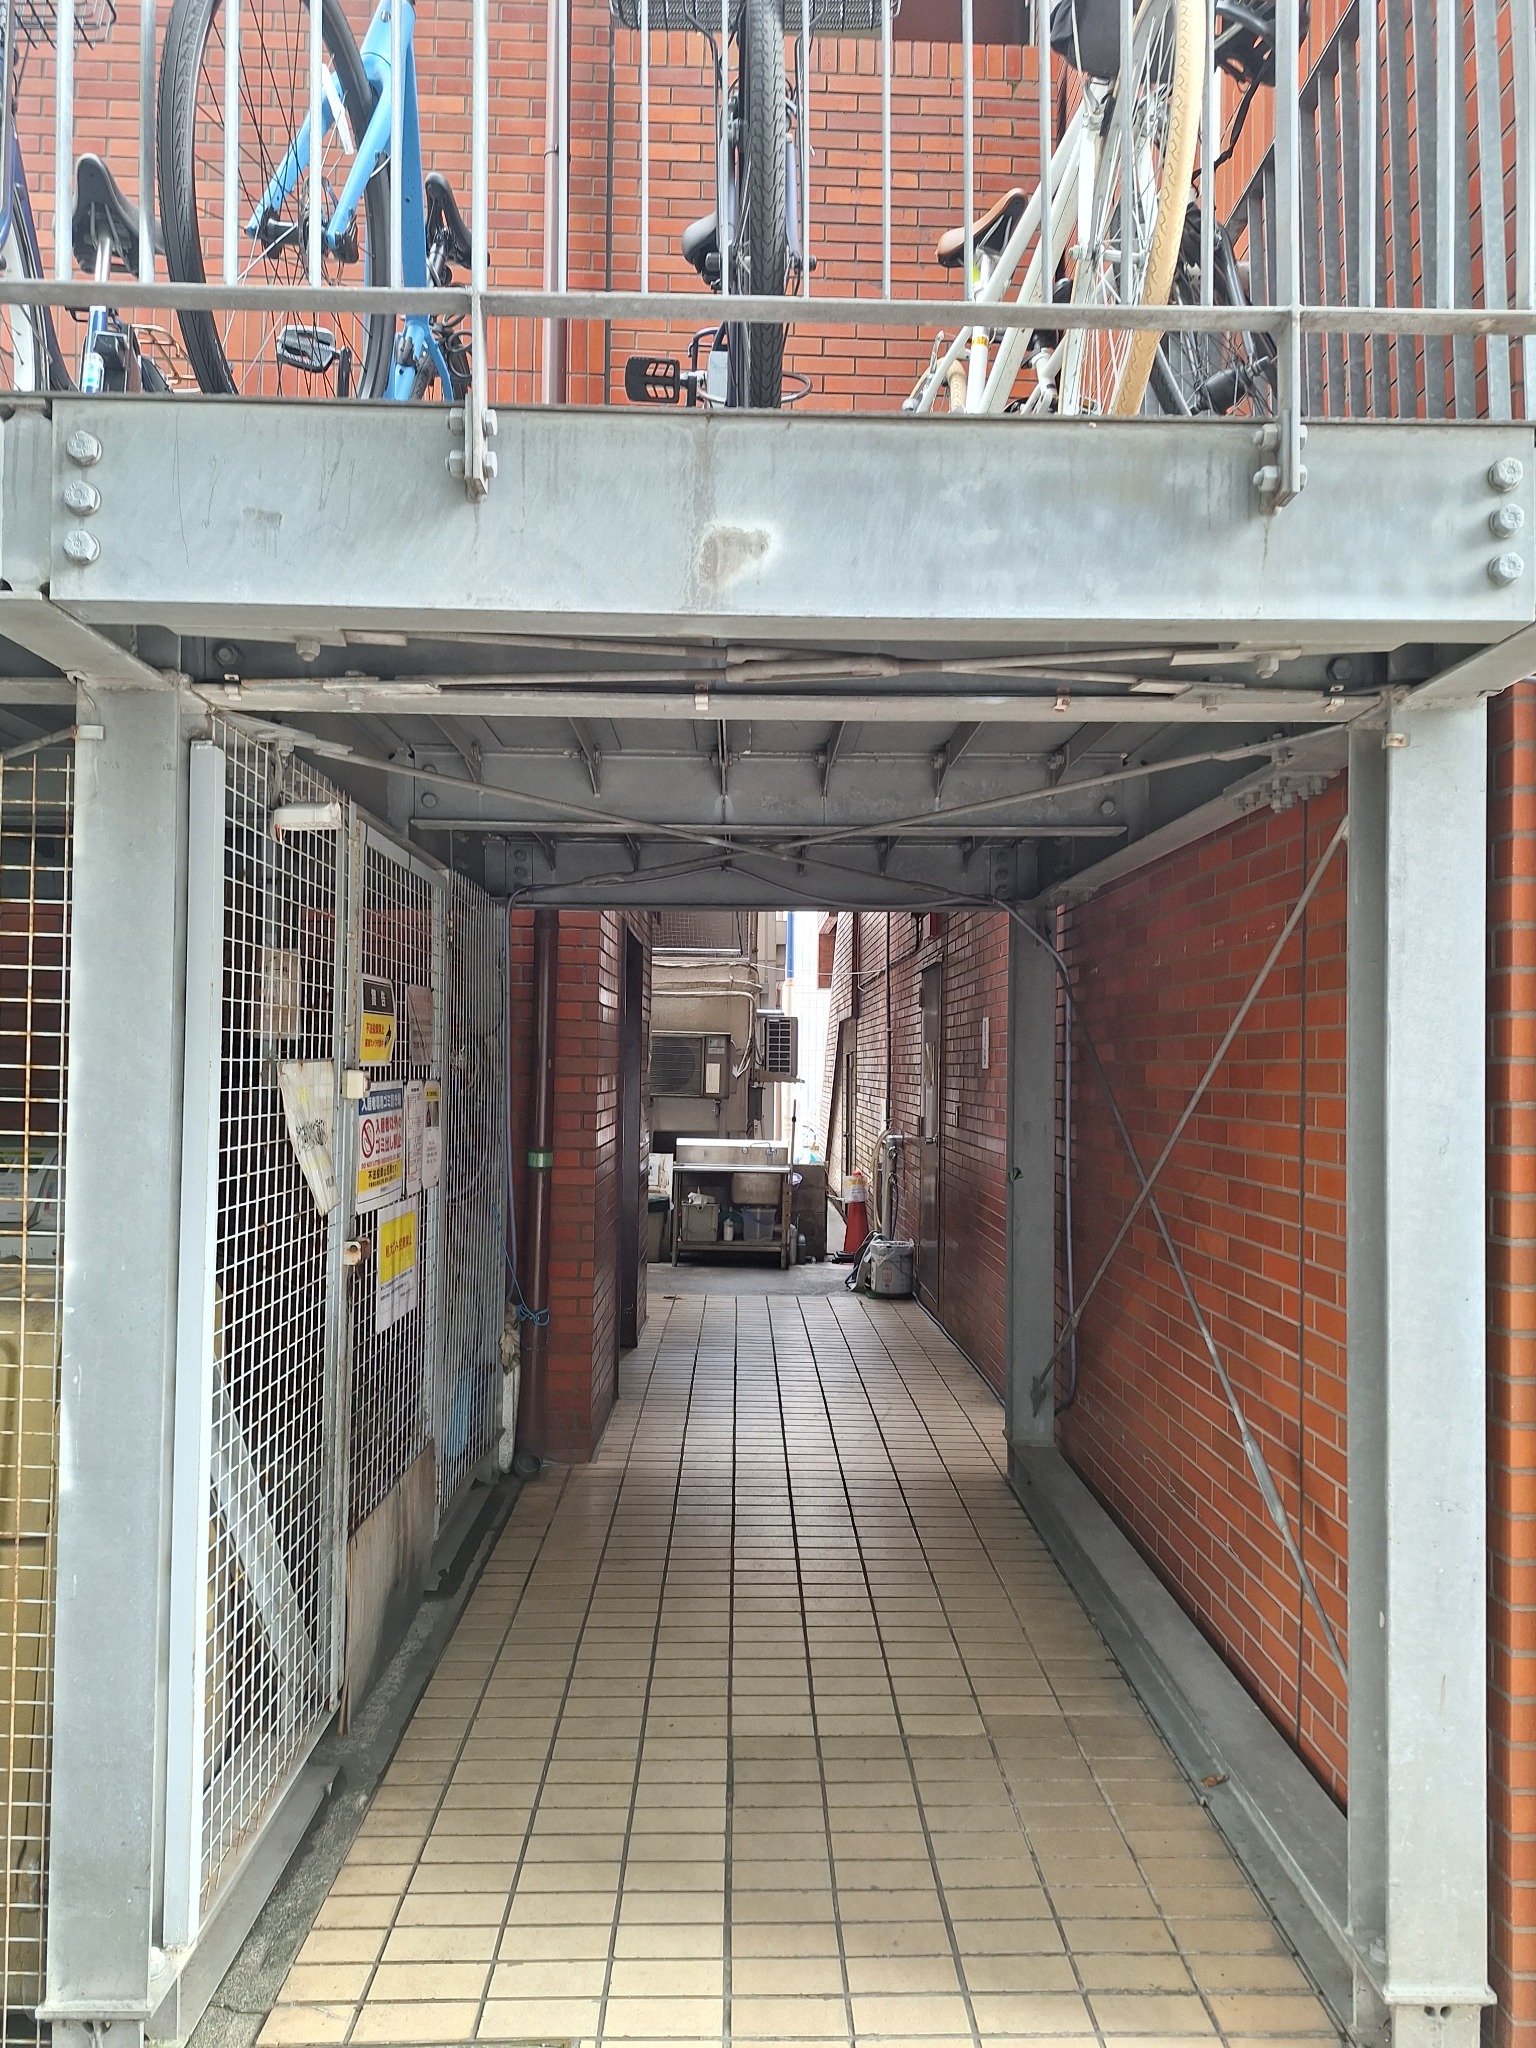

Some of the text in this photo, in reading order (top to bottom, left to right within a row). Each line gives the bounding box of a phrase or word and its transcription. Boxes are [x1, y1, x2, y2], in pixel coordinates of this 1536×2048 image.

[376, 1116, 402, 1135] 入居者以外の
